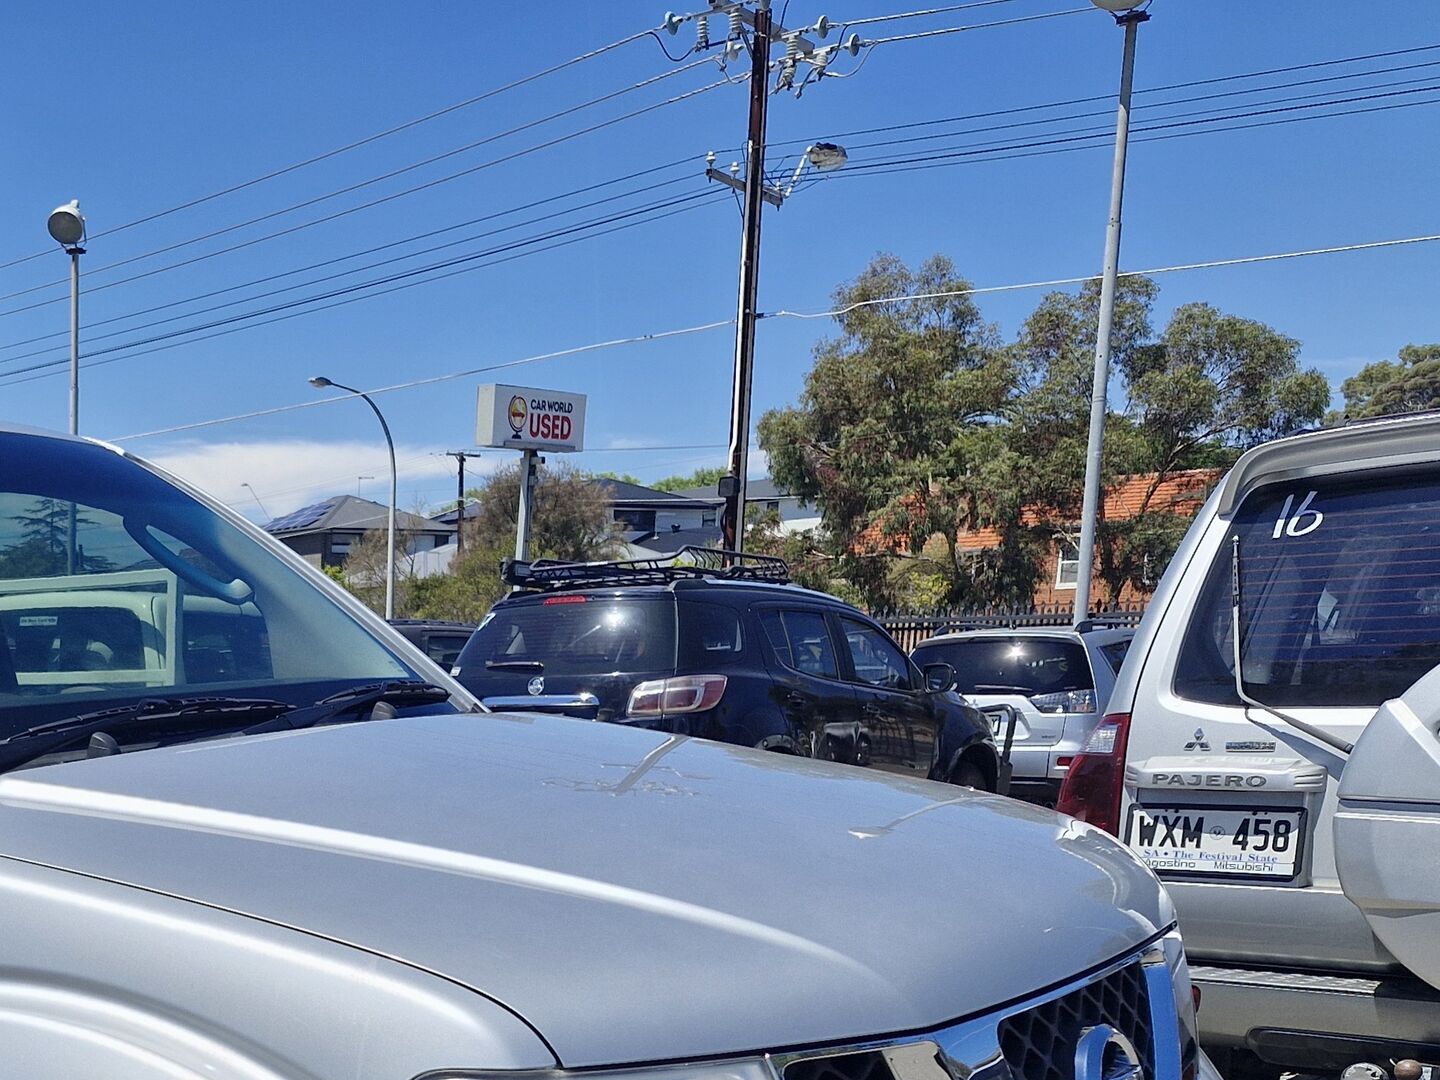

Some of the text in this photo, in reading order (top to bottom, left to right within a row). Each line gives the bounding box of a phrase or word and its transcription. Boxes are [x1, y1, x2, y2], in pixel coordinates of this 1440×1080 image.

[530, 399, 573, 414] CAR WORLD
[529, 413, 572, 440] USED
[1272, 490, 1323, 539] 16
[1151, 774, 1267, 788] PAJERO
[1139, 815, 1291, 853] WXM 458
[1143, 849, 1278, 863] SA The Festival State
[1214, 861, 1274, 872] Mitsubishi
